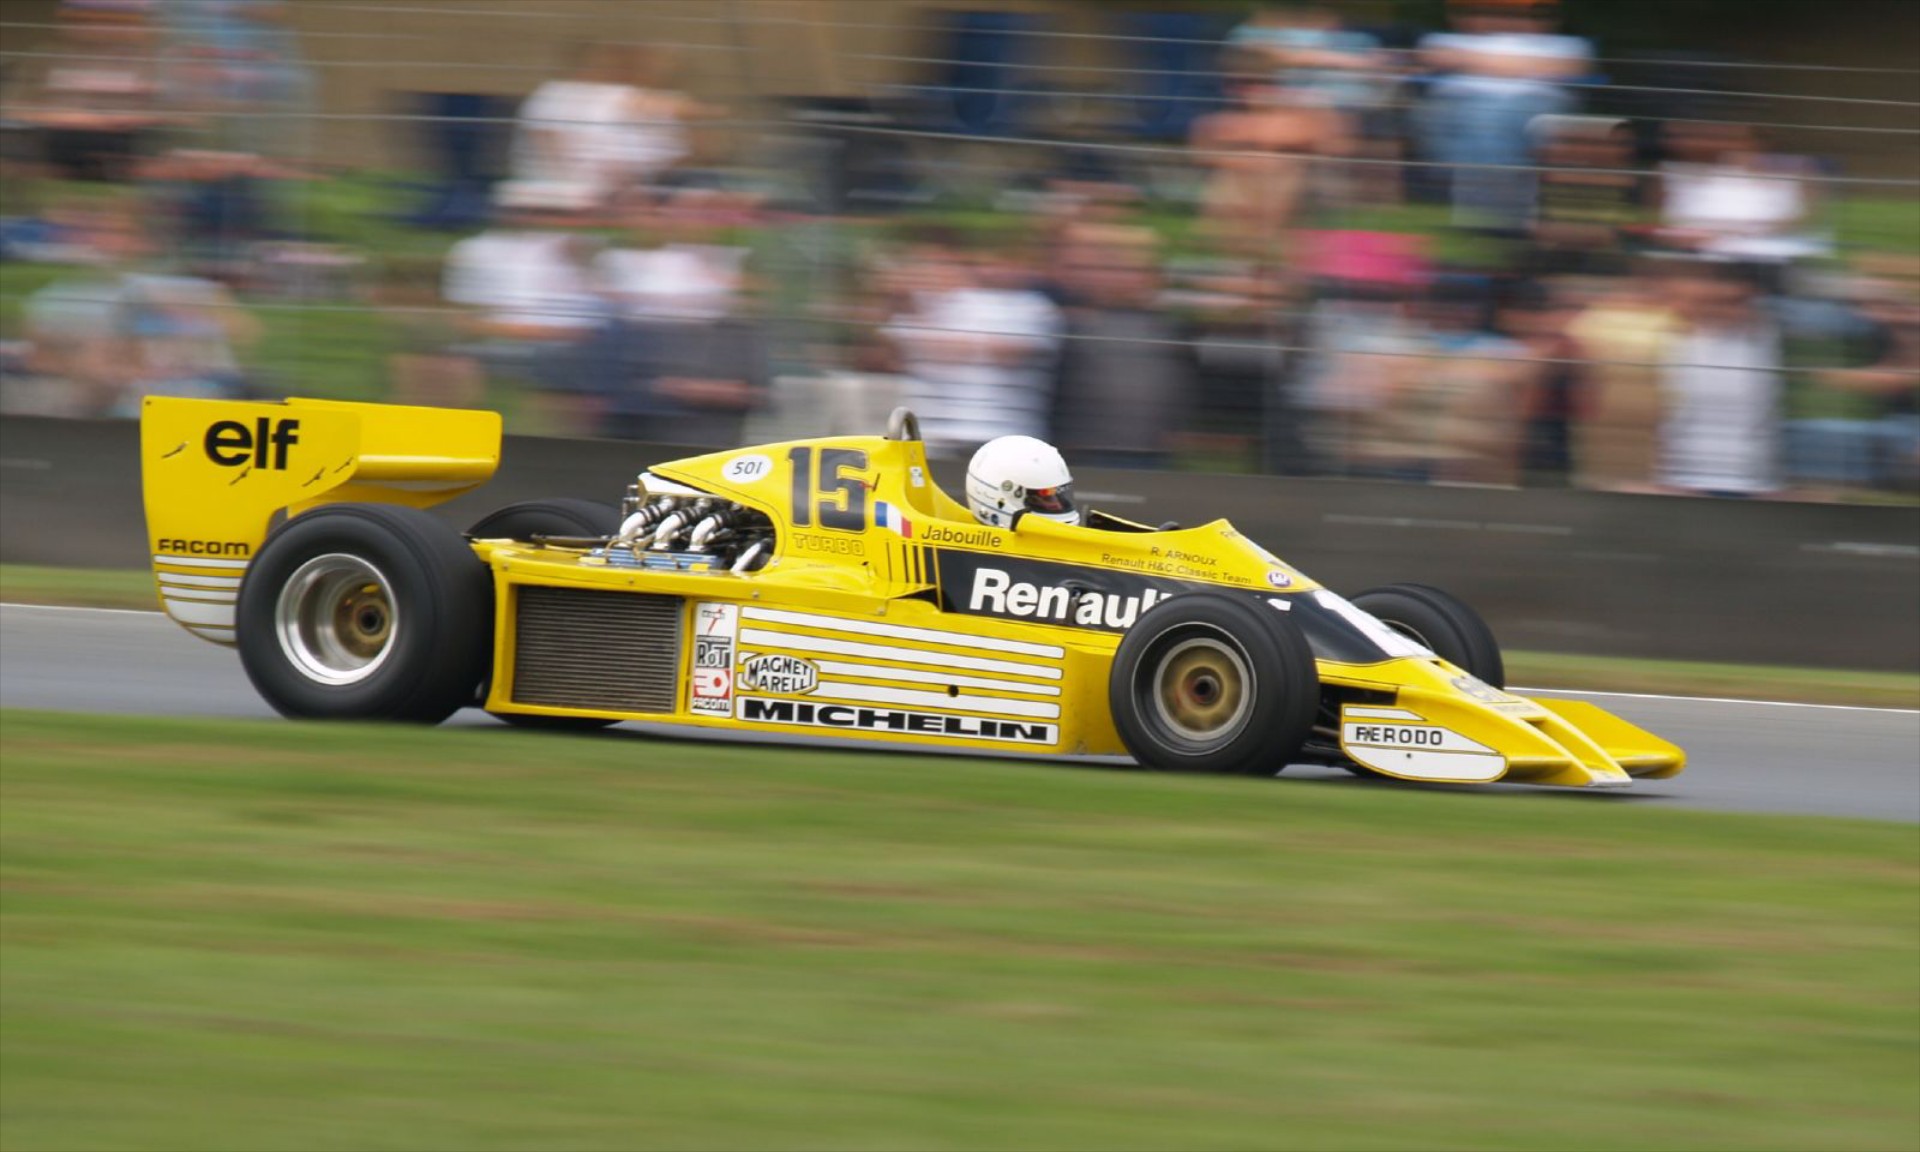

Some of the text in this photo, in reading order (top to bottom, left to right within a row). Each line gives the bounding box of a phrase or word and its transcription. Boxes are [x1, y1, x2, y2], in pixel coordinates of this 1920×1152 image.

[204, 417, 299, 470] elf
[732, 461, 763, 476] 501
[788, 446, 869, 532] 15
[158, 538, 249, 555] FACOM
[792, 533, 864, 556] TURBO
[921, 525, 1002, 548] Jabouille
[1101, 553, 1145, 569] Renault
[1148, 560, 1175, 573] H&C
[1176, 564, 1217, 580] Classic
[1222, 571, 1252, 585] Team
[1166, 549, 1217, 566] ARNOUX
[969, 567, 1173, 629] Renaul
[743, 699, 1048, 741] MICHELIN
[1355, 726, 1443, 746] FERODO
